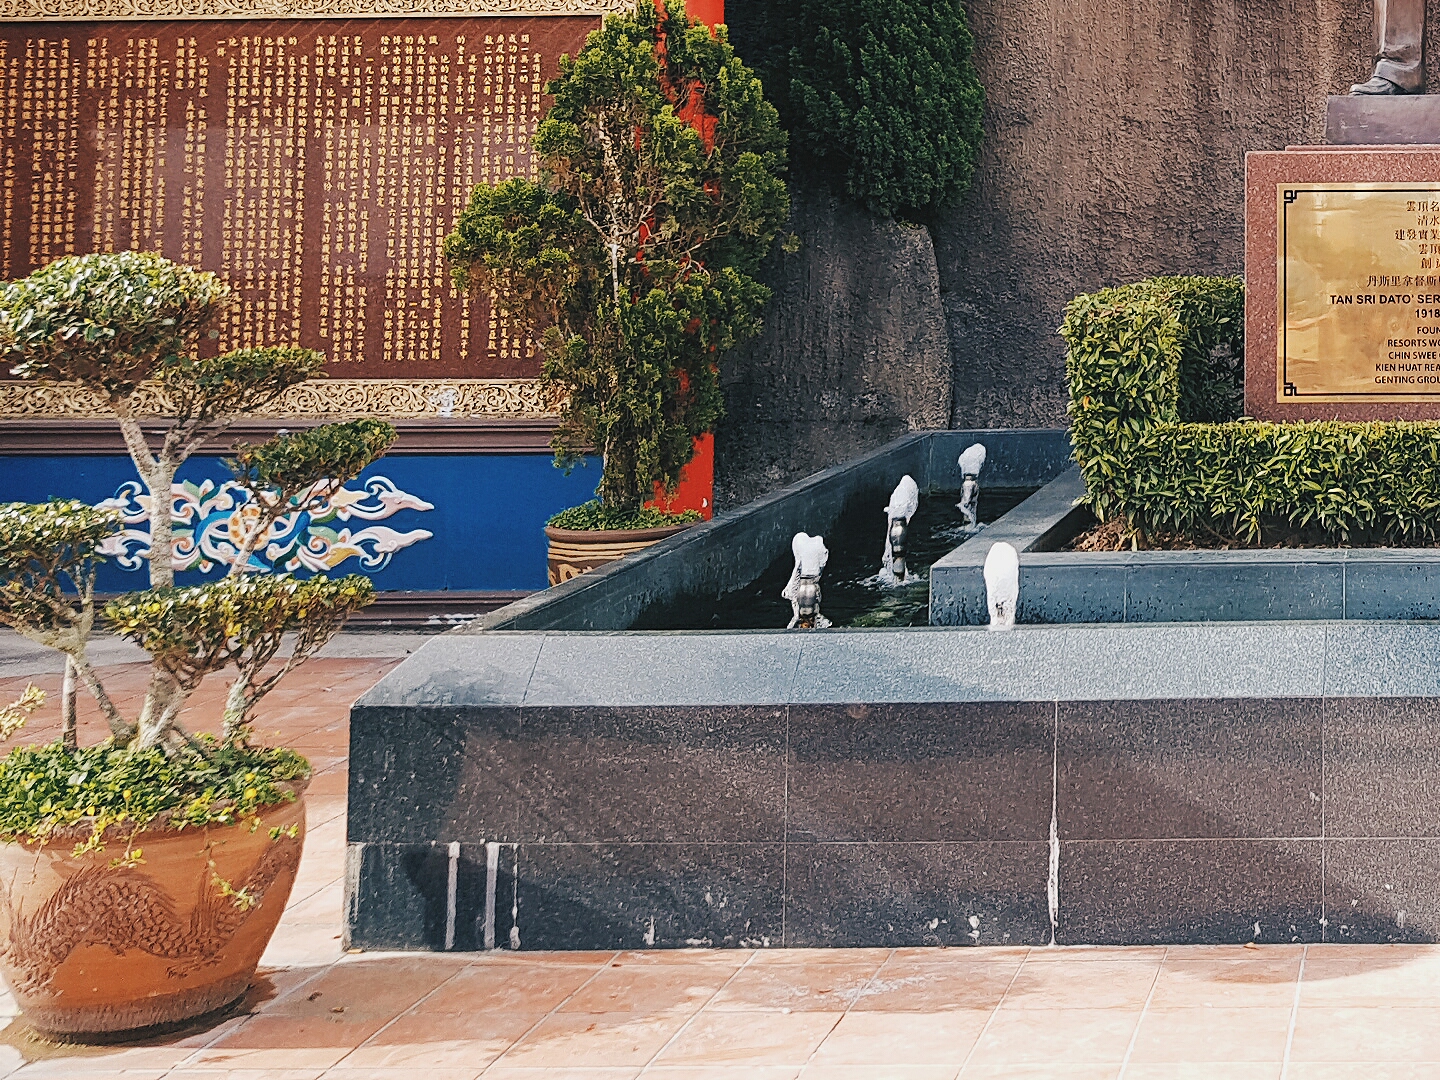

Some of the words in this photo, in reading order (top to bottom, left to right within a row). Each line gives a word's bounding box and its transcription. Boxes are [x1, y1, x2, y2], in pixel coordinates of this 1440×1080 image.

[1330, 295, 1353, 304] TAN
[1356, 295, 1375, 304] SRI
[1380, 295, 1414, 304] DATO'
[1415, 309, 1440, 318] 1918
[1387, 339, 1427, 347] RESORTS
[1388, 351, 1410, 359] CHIN
[1413, 351, 1437, 359] SWEE
[1375, 376, 1414, 384] GENTING
